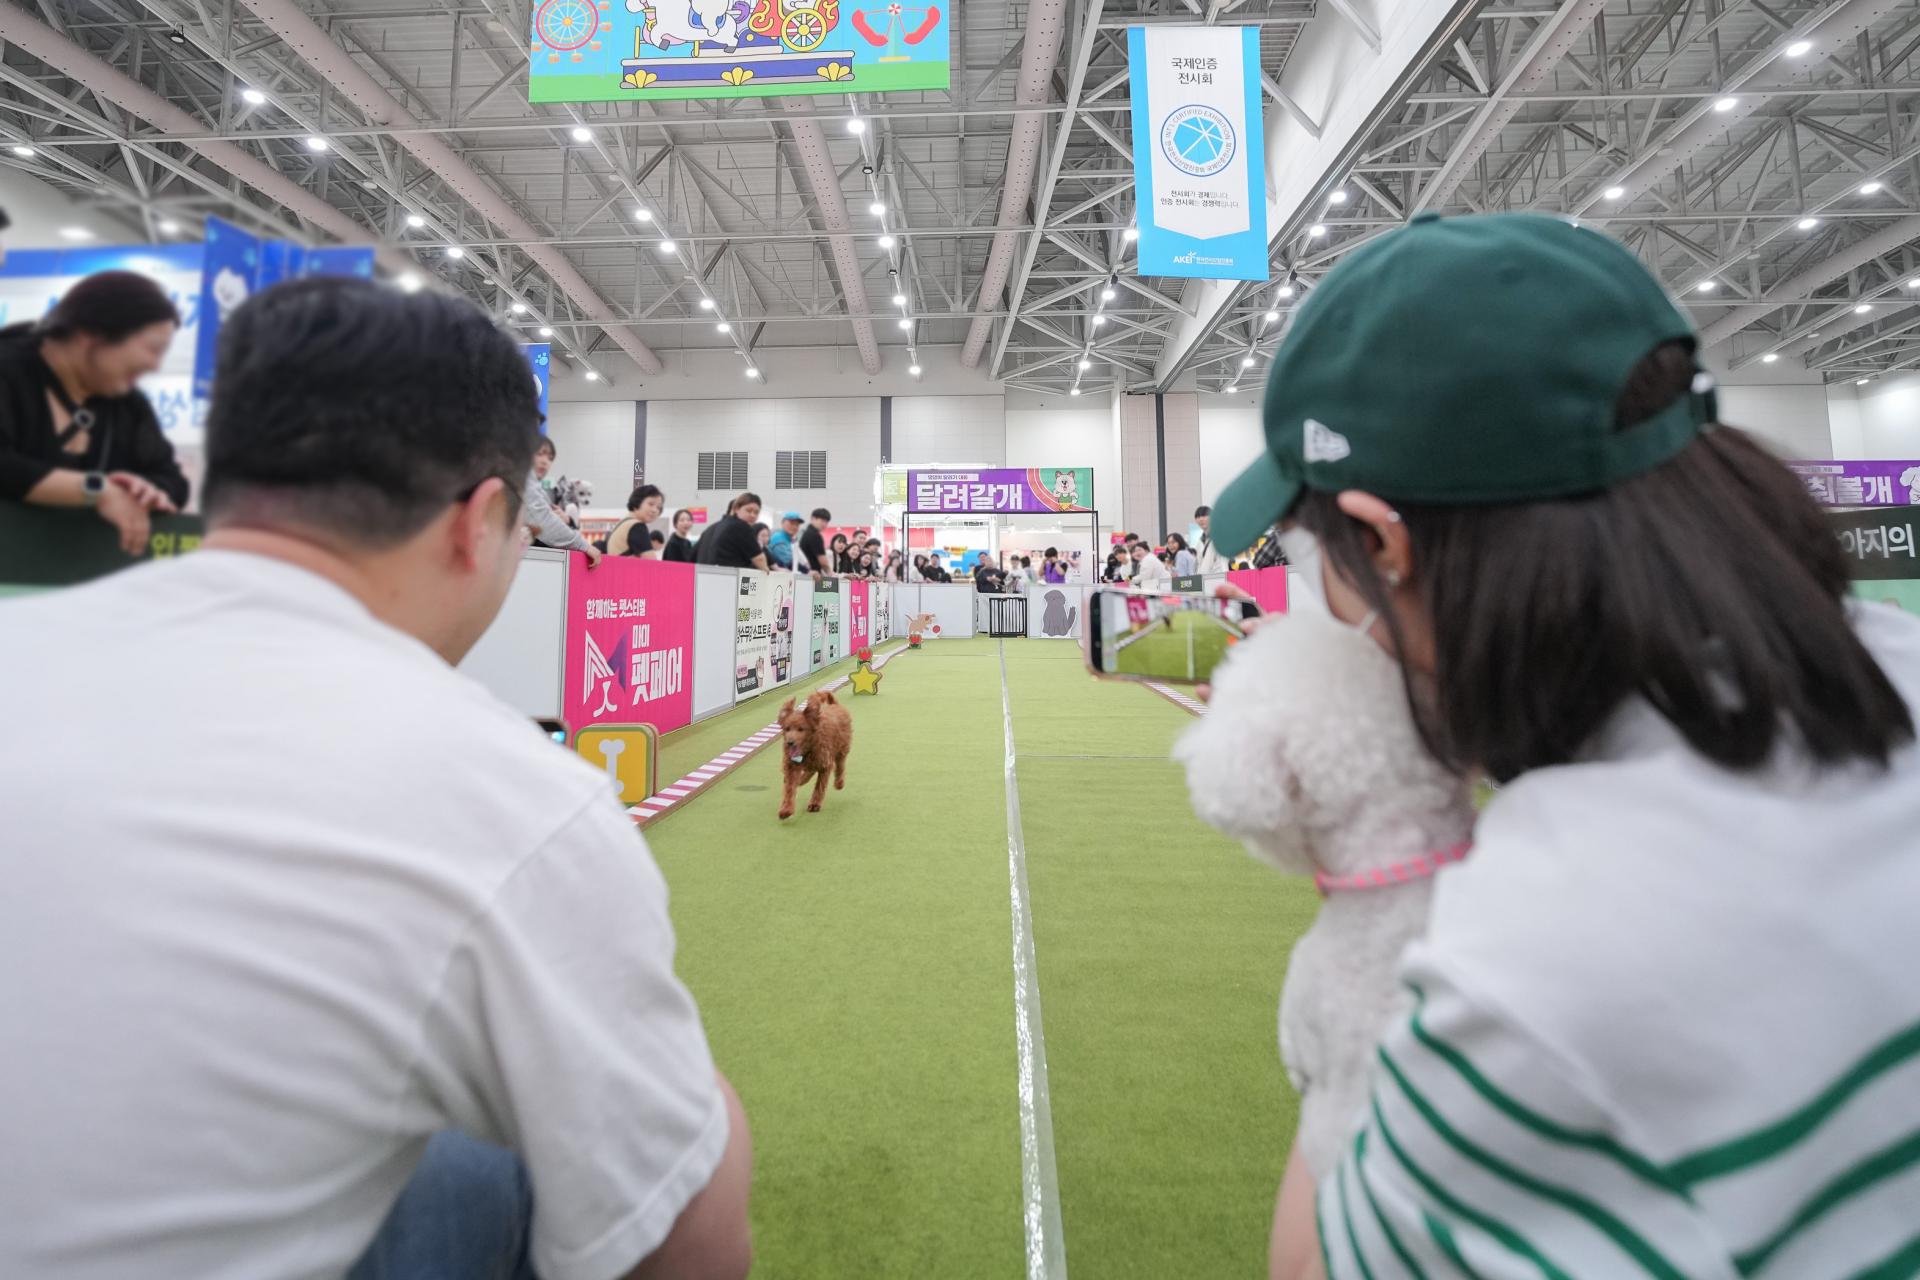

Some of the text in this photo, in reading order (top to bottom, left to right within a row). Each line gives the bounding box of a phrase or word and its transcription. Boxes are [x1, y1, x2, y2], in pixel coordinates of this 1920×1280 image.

[1171, 57, 1218, 70] 국제인증
[1178, 72, 1213, 85] 전시회
[1173, 253, 1194, 264] AKEI
[917, 483, 1022, 510] 달려갈개
[1836, 524, 1916, 560] 아지의
[586, 598, 646, 620] 함께하는 펫스티벌
[632, 624, 650, 649] 마이
[631, 647, 683, 706] 펫페어
